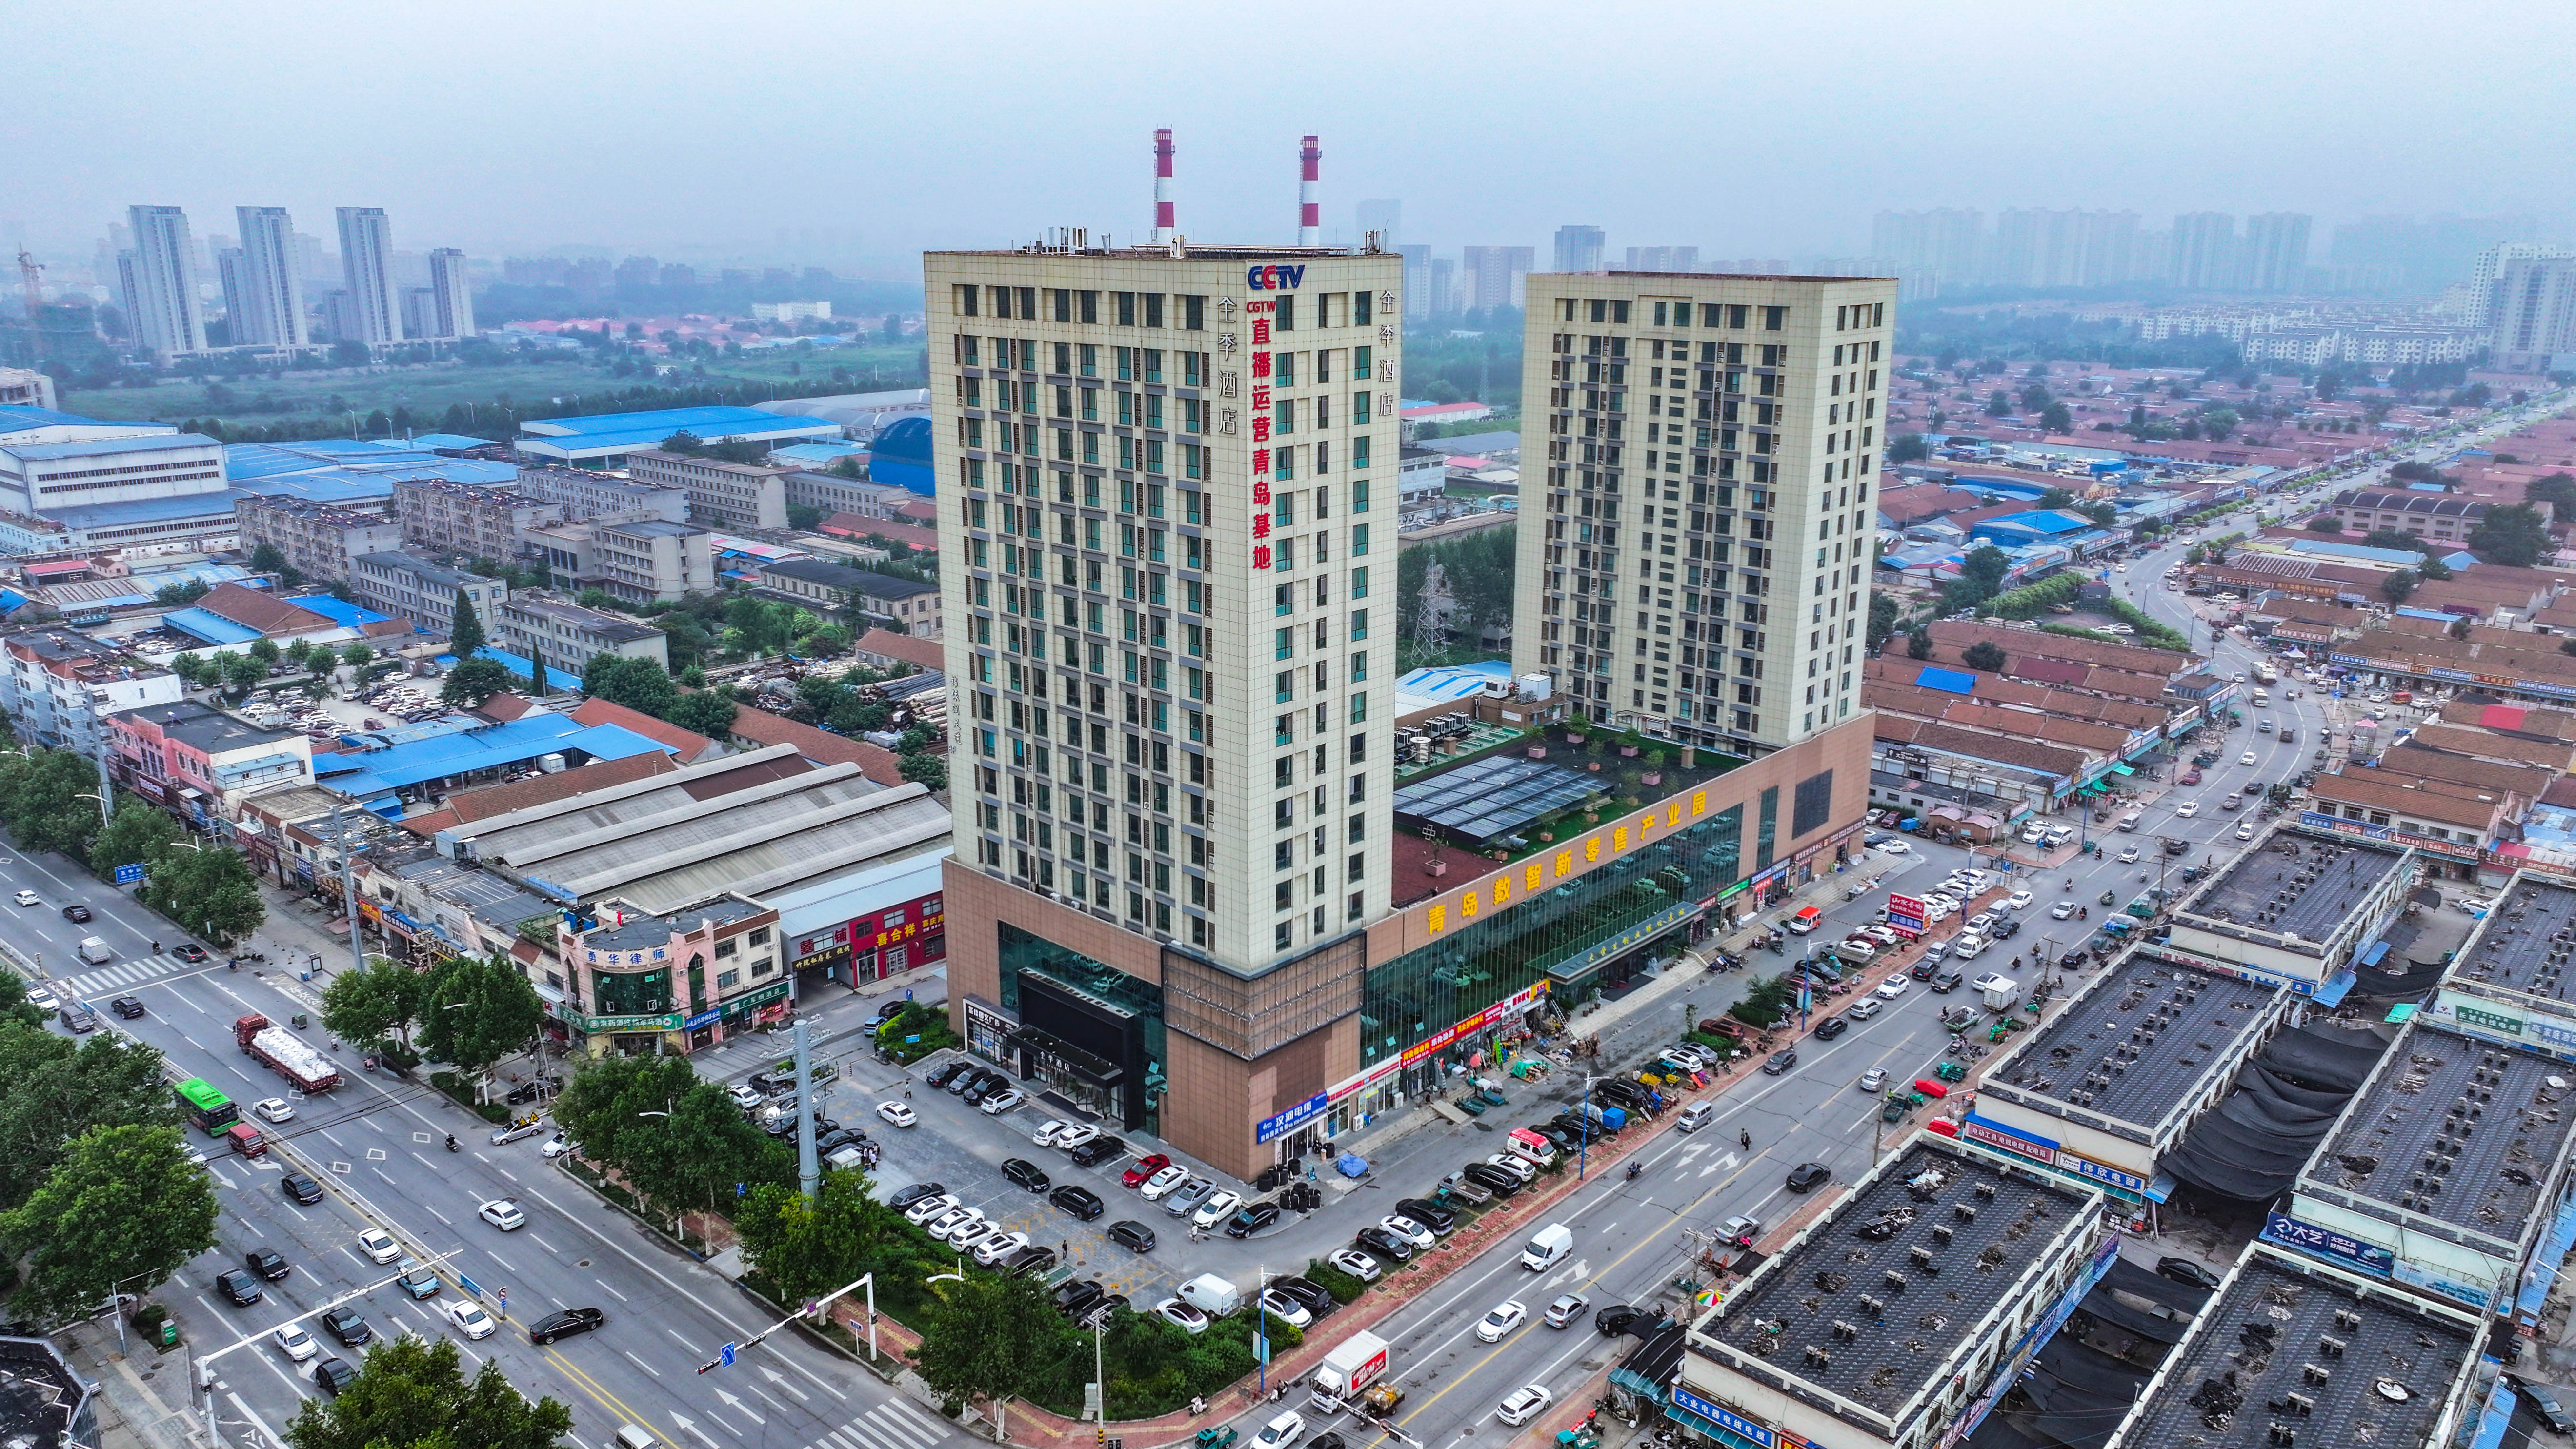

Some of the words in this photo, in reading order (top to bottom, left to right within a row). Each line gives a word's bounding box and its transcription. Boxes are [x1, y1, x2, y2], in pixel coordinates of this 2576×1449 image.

[1248, 265, 1305, 290] CCTV
[1247, 301, 1277, 313] CGTW
[1379, 290, 1394, 416] 全季酒店
[1218, 296, 1236, 435] 全季酒店
[1251, 318, 1271, 570] 直播运营青岛基地
[1428, 791, 1706, 935] 青岛数智新零售产业园
[1892, 897, 1923, 910] 山水音响
[1892, 914, 1922, 928] 贝德音响
[877, 923, 916, 946] 喜合祥
[588, 948, 664, 965] 勇华律师
[2458, 1012, 2517, 1032] 长城电线电缆
[1040, 1051, 1070, 1072] 全季酒店
[1972, 1127, 1997, 1142] 电动工具
[1999, 1137, 2025, 1151] 电线电缆
[2026, 1145, 2047, 1158] 配电箱
[2084, 1163, 2136, 1188] 伟欣电器
[2293, 1225, 2323, 1245] 大艺
[2331, 1235, 2356, 1249] 大艺工具
[1679, 1394, 1766, 1442] 大业电器电线电缆
